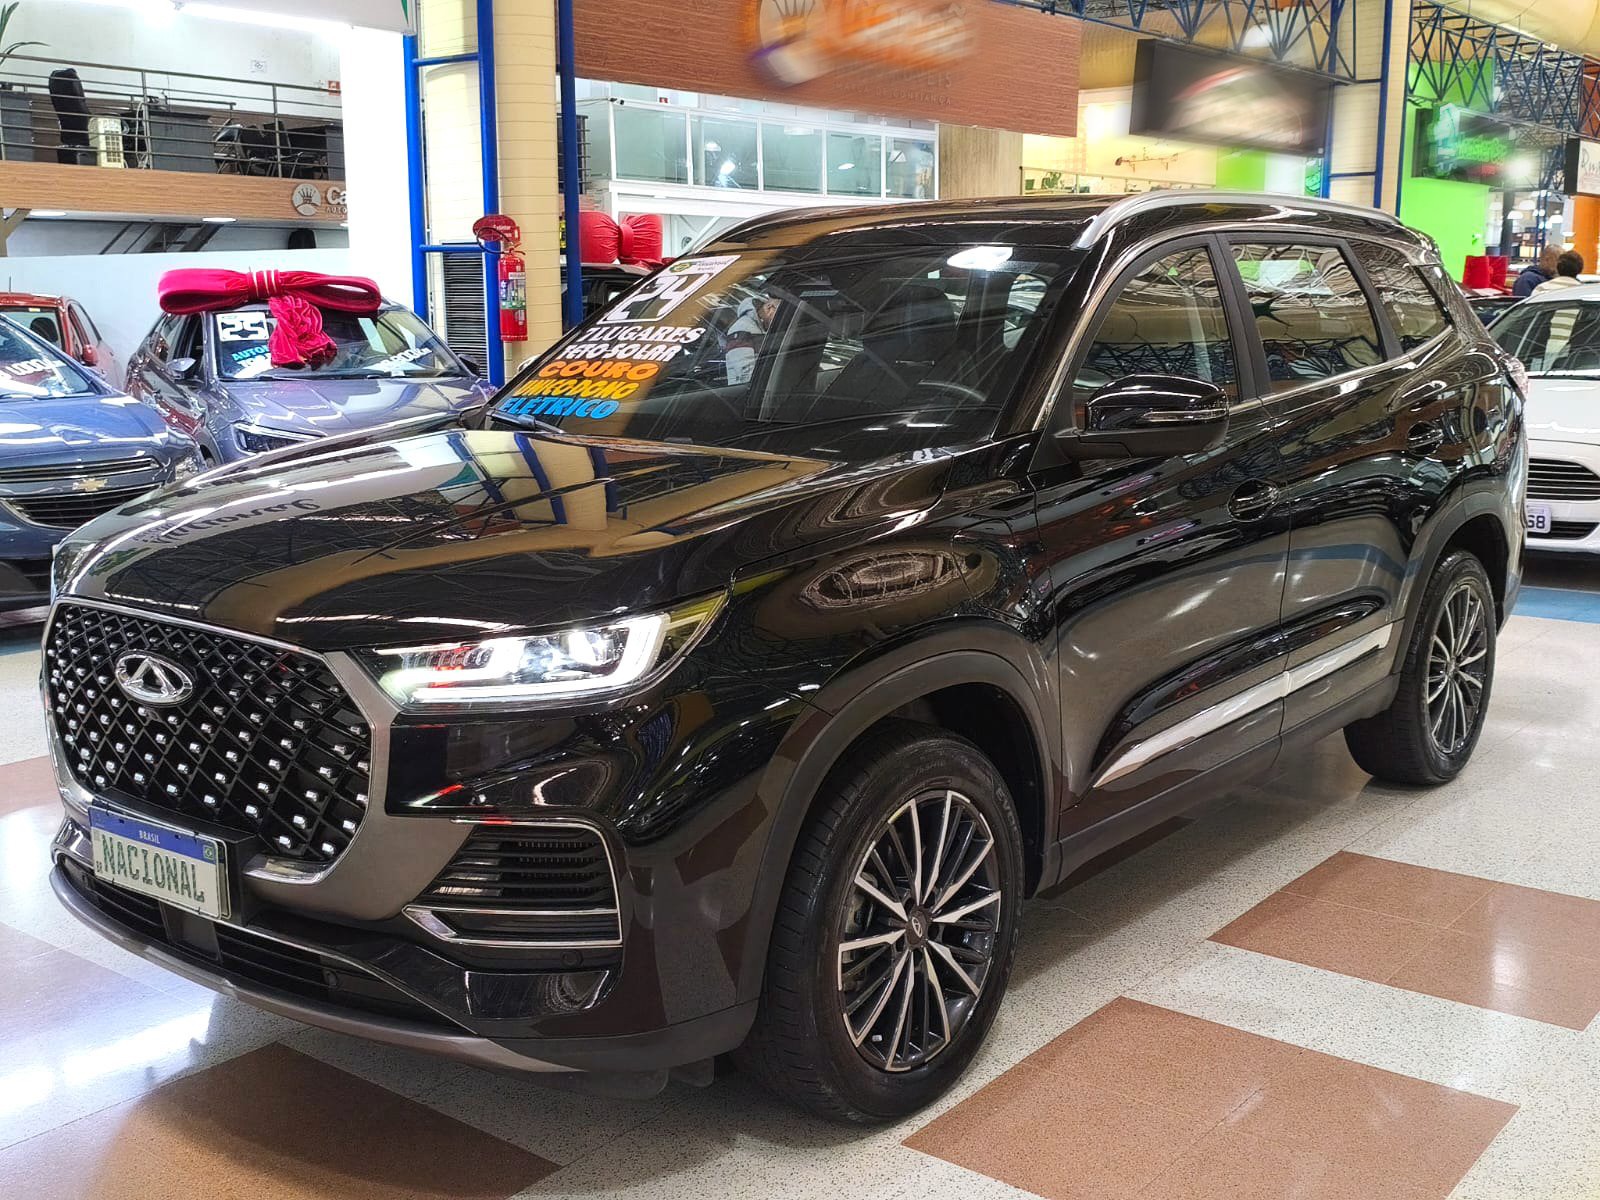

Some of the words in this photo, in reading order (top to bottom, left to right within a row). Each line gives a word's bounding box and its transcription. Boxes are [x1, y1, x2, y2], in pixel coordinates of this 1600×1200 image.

[605, 274, 714, 321] 24
[220, 320, 267, 340] 25
[539, 361, 660, 380] COURO
[499, 397, 619, 419] ELÉTRICO
[138, 830, 161, 844] BRASIL
[102, 834, 205, 903] NACIONAL
